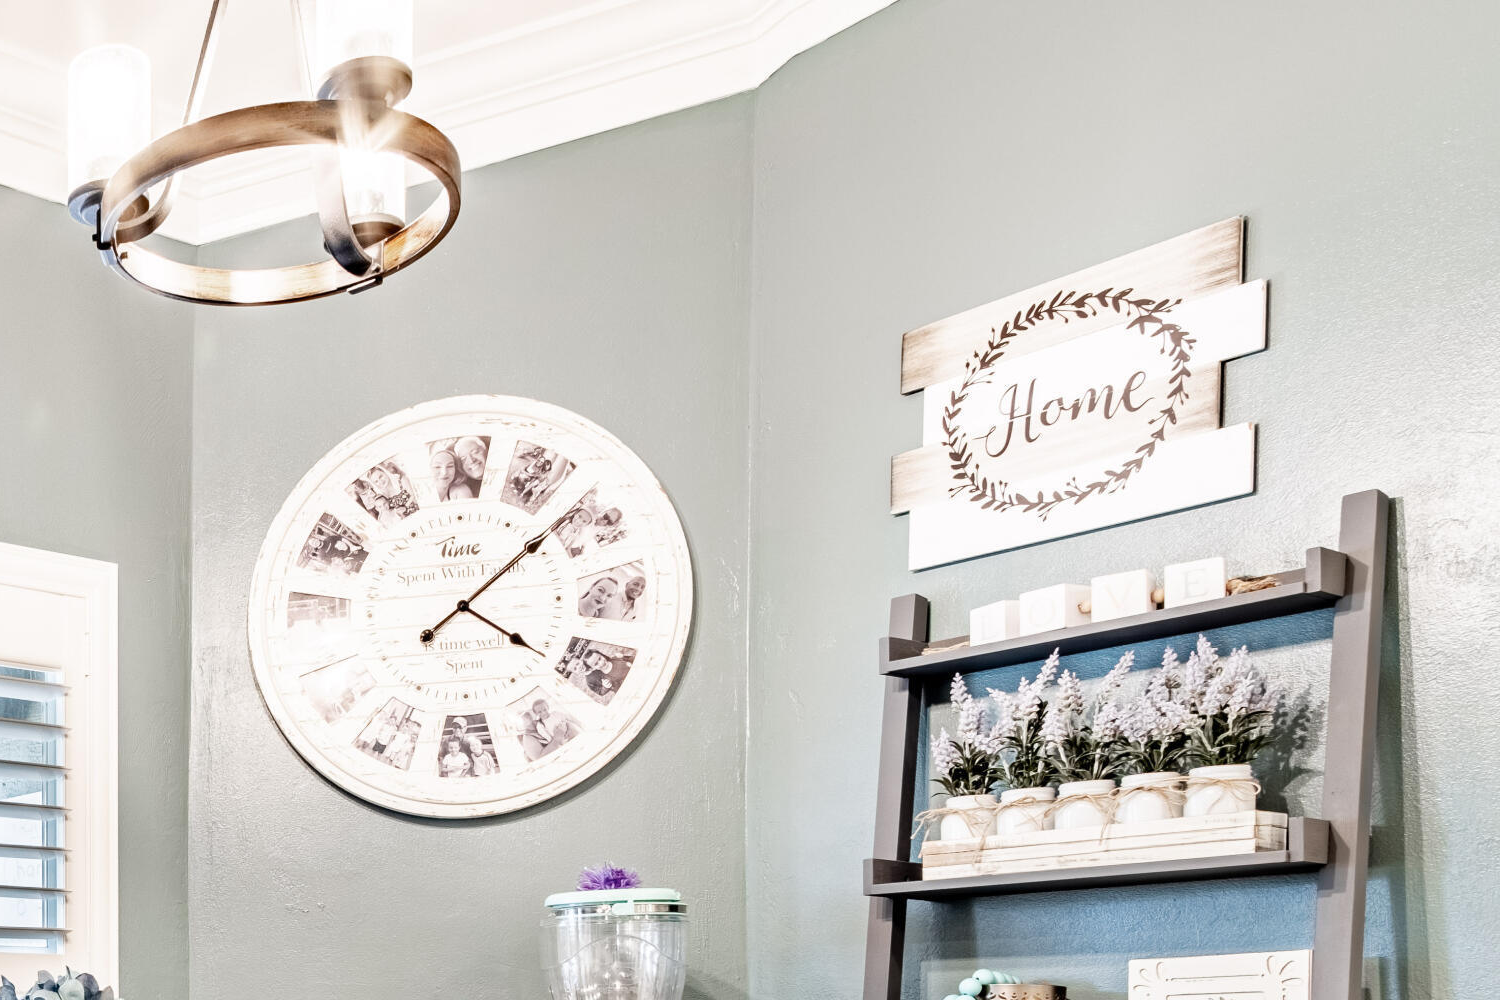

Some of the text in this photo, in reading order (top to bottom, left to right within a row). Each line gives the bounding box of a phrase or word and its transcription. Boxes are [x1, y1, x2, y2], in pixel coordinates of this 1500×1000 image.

[973, 370, 1155, 458] Home
[436, 535, 482, 559] Time
[396, 570, 436, 587] Spent
[441, 564, 476, 580] With
[439, 636, 474, 650] time
[476, 632, 506, 648] well
[444, 658, 484, 675] Spent
